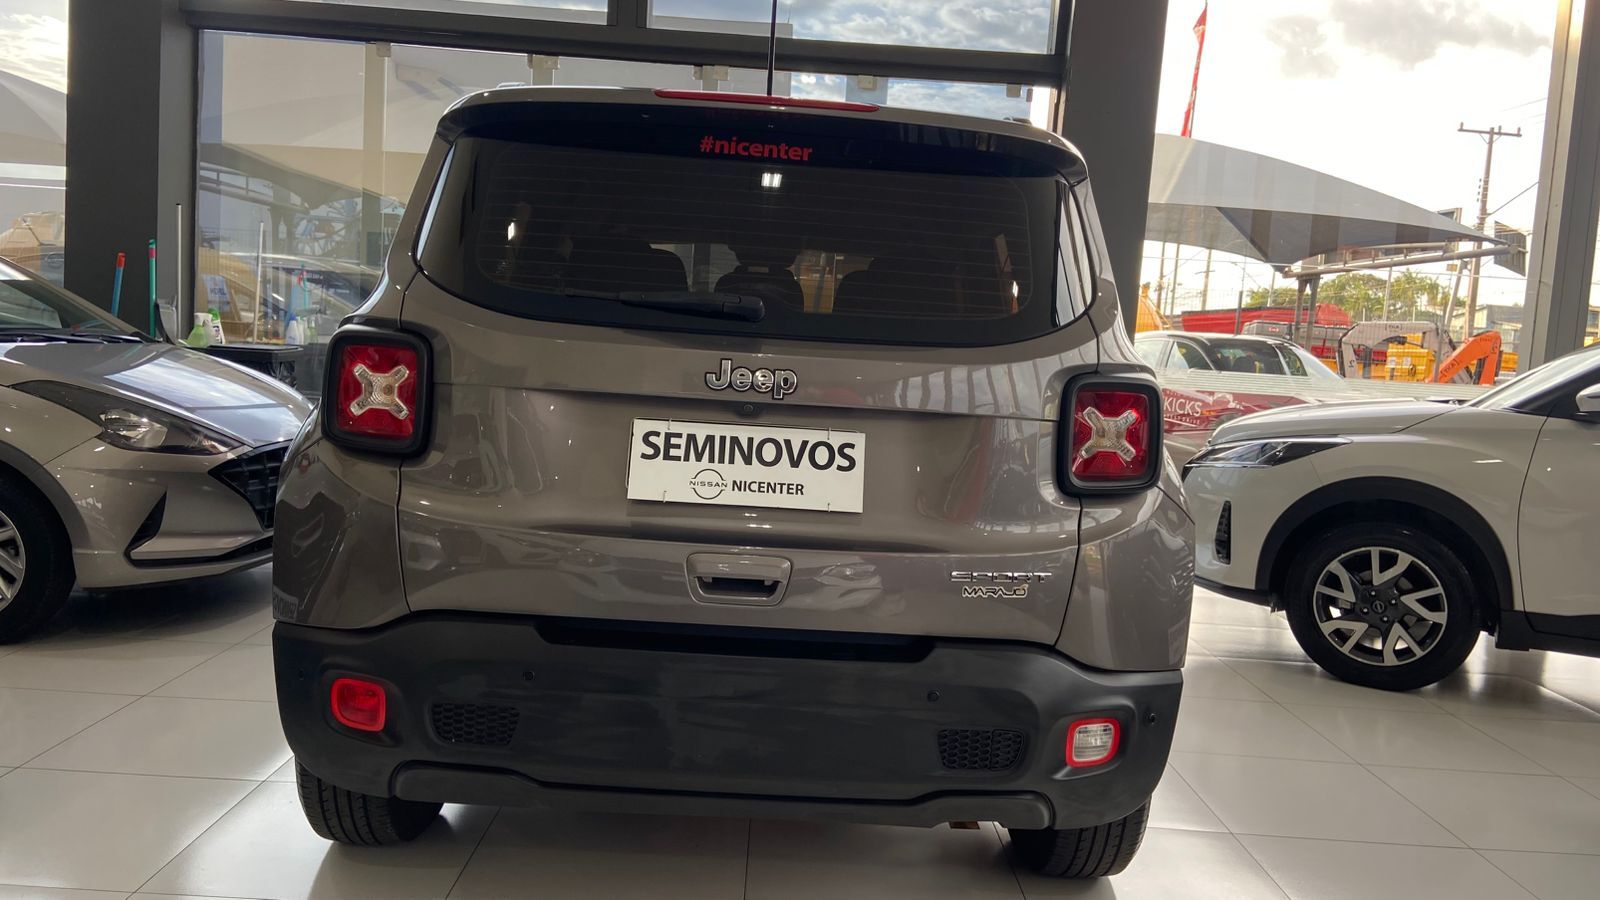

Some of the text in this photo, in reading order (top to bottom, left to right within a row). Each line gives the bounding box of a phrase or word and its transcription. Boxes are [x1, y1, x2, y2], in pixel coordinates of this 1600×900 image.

[699, 135, 813, 161] #nicenter
[705, 358, 798, 399] Jeep
[1163, 396, 1202, 417] KICKS
[640, 430, 857, 472] SEMINOVOS
[689, 480, 805, 496] NISSAN NICENTER
[950, 571, 1053, 583] SPORT
